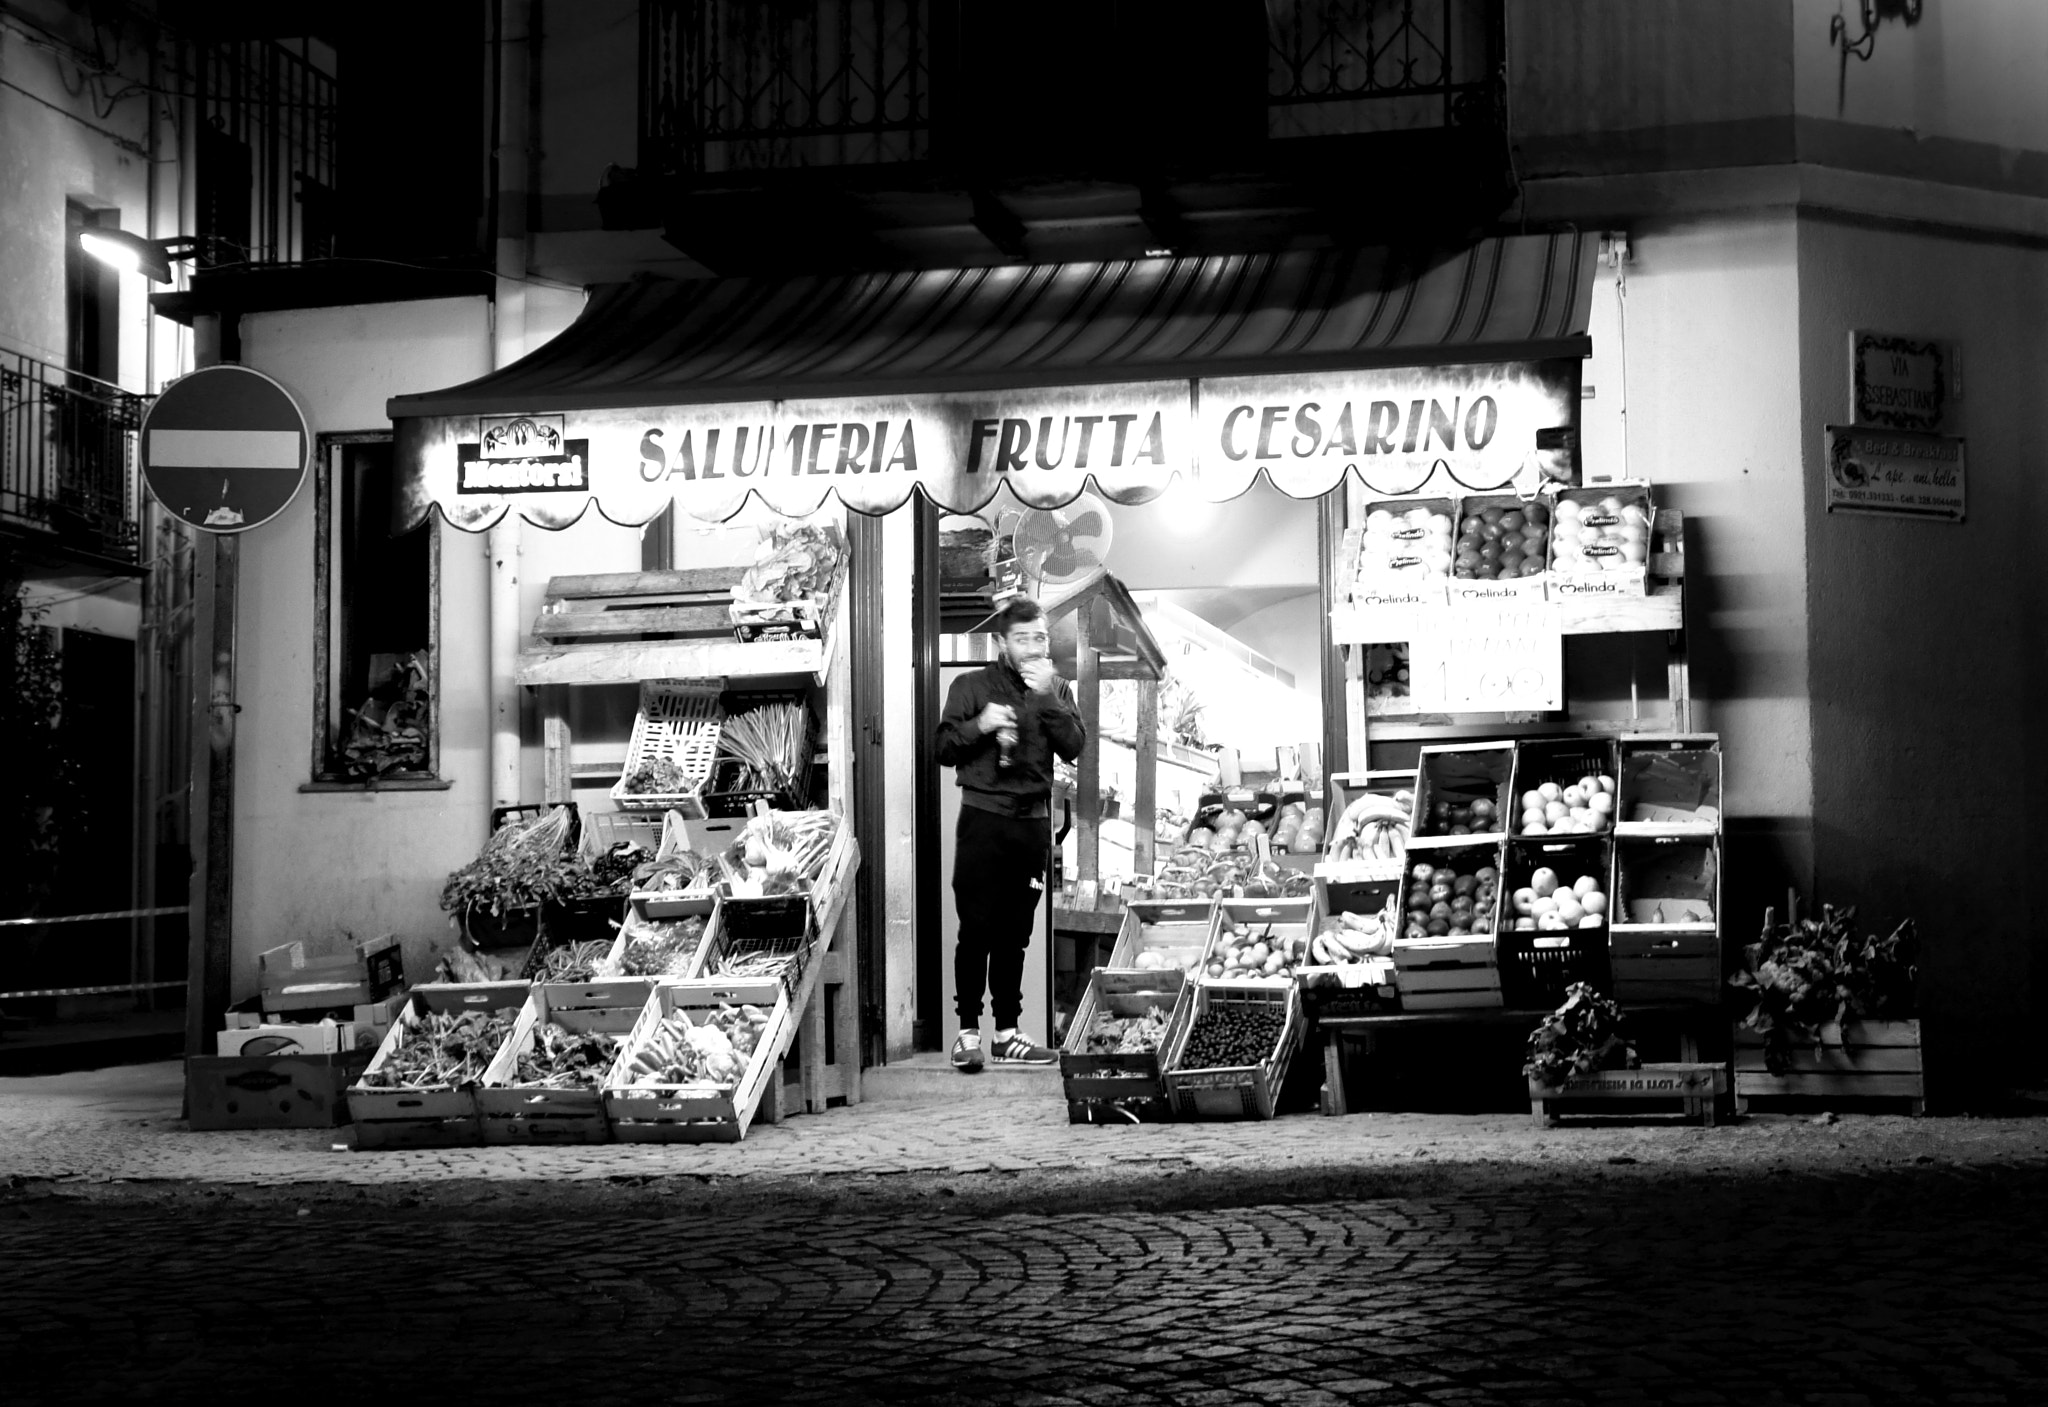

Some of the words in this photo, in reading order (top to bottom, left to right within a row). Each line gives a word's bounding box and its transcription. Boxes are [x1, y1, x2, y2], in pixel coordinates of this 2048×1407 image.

[1890, 355, 1909, 377] VIA
[639, 418, 918, 483] SALUMERIA
[966, 411, 1166, 473] FRUTTA
[1221, 395, 1498, 461] CESARINO
[1462, 587, 1517, 598] Melinda
[1560, 581, 1615, 593] Melinda
[1365, 593, 1419, 605] Melinda
